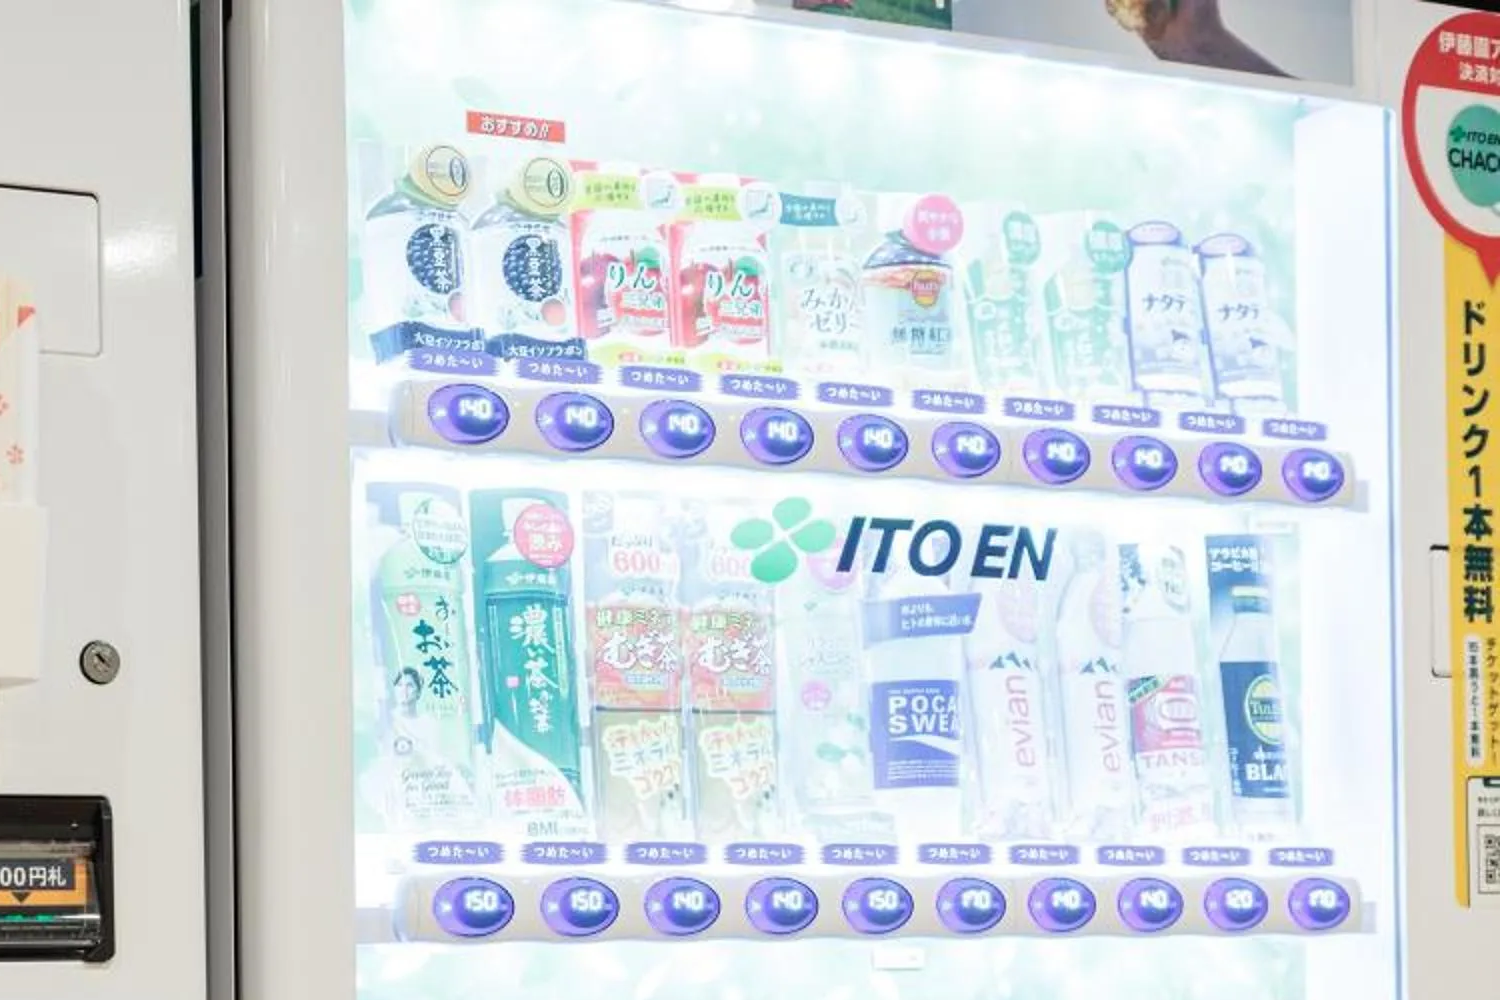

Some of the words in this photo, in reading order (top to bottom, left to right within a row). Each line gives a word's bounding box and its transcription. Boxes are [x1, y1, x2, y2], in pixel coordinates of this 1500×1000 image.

[459, 401, 491, 418] 140
[567, 407, 598, 427] 140
[668, 414, 699, 434] 140
[767, 421, 798, 442] 140
[863, 430, 892, 449] 140
[836, 515, 963, 576] ITO
[971, 524, 1058, 582] EN
[412, 618, 459, 699] お茶
[1004, 673, 1037, 769] evian
[1096, 679, 1124, 773] evian
[465, 892, 498, 910] 150
[570, 892, 602, 910] 150
[672, 892, 703, 910] 140
